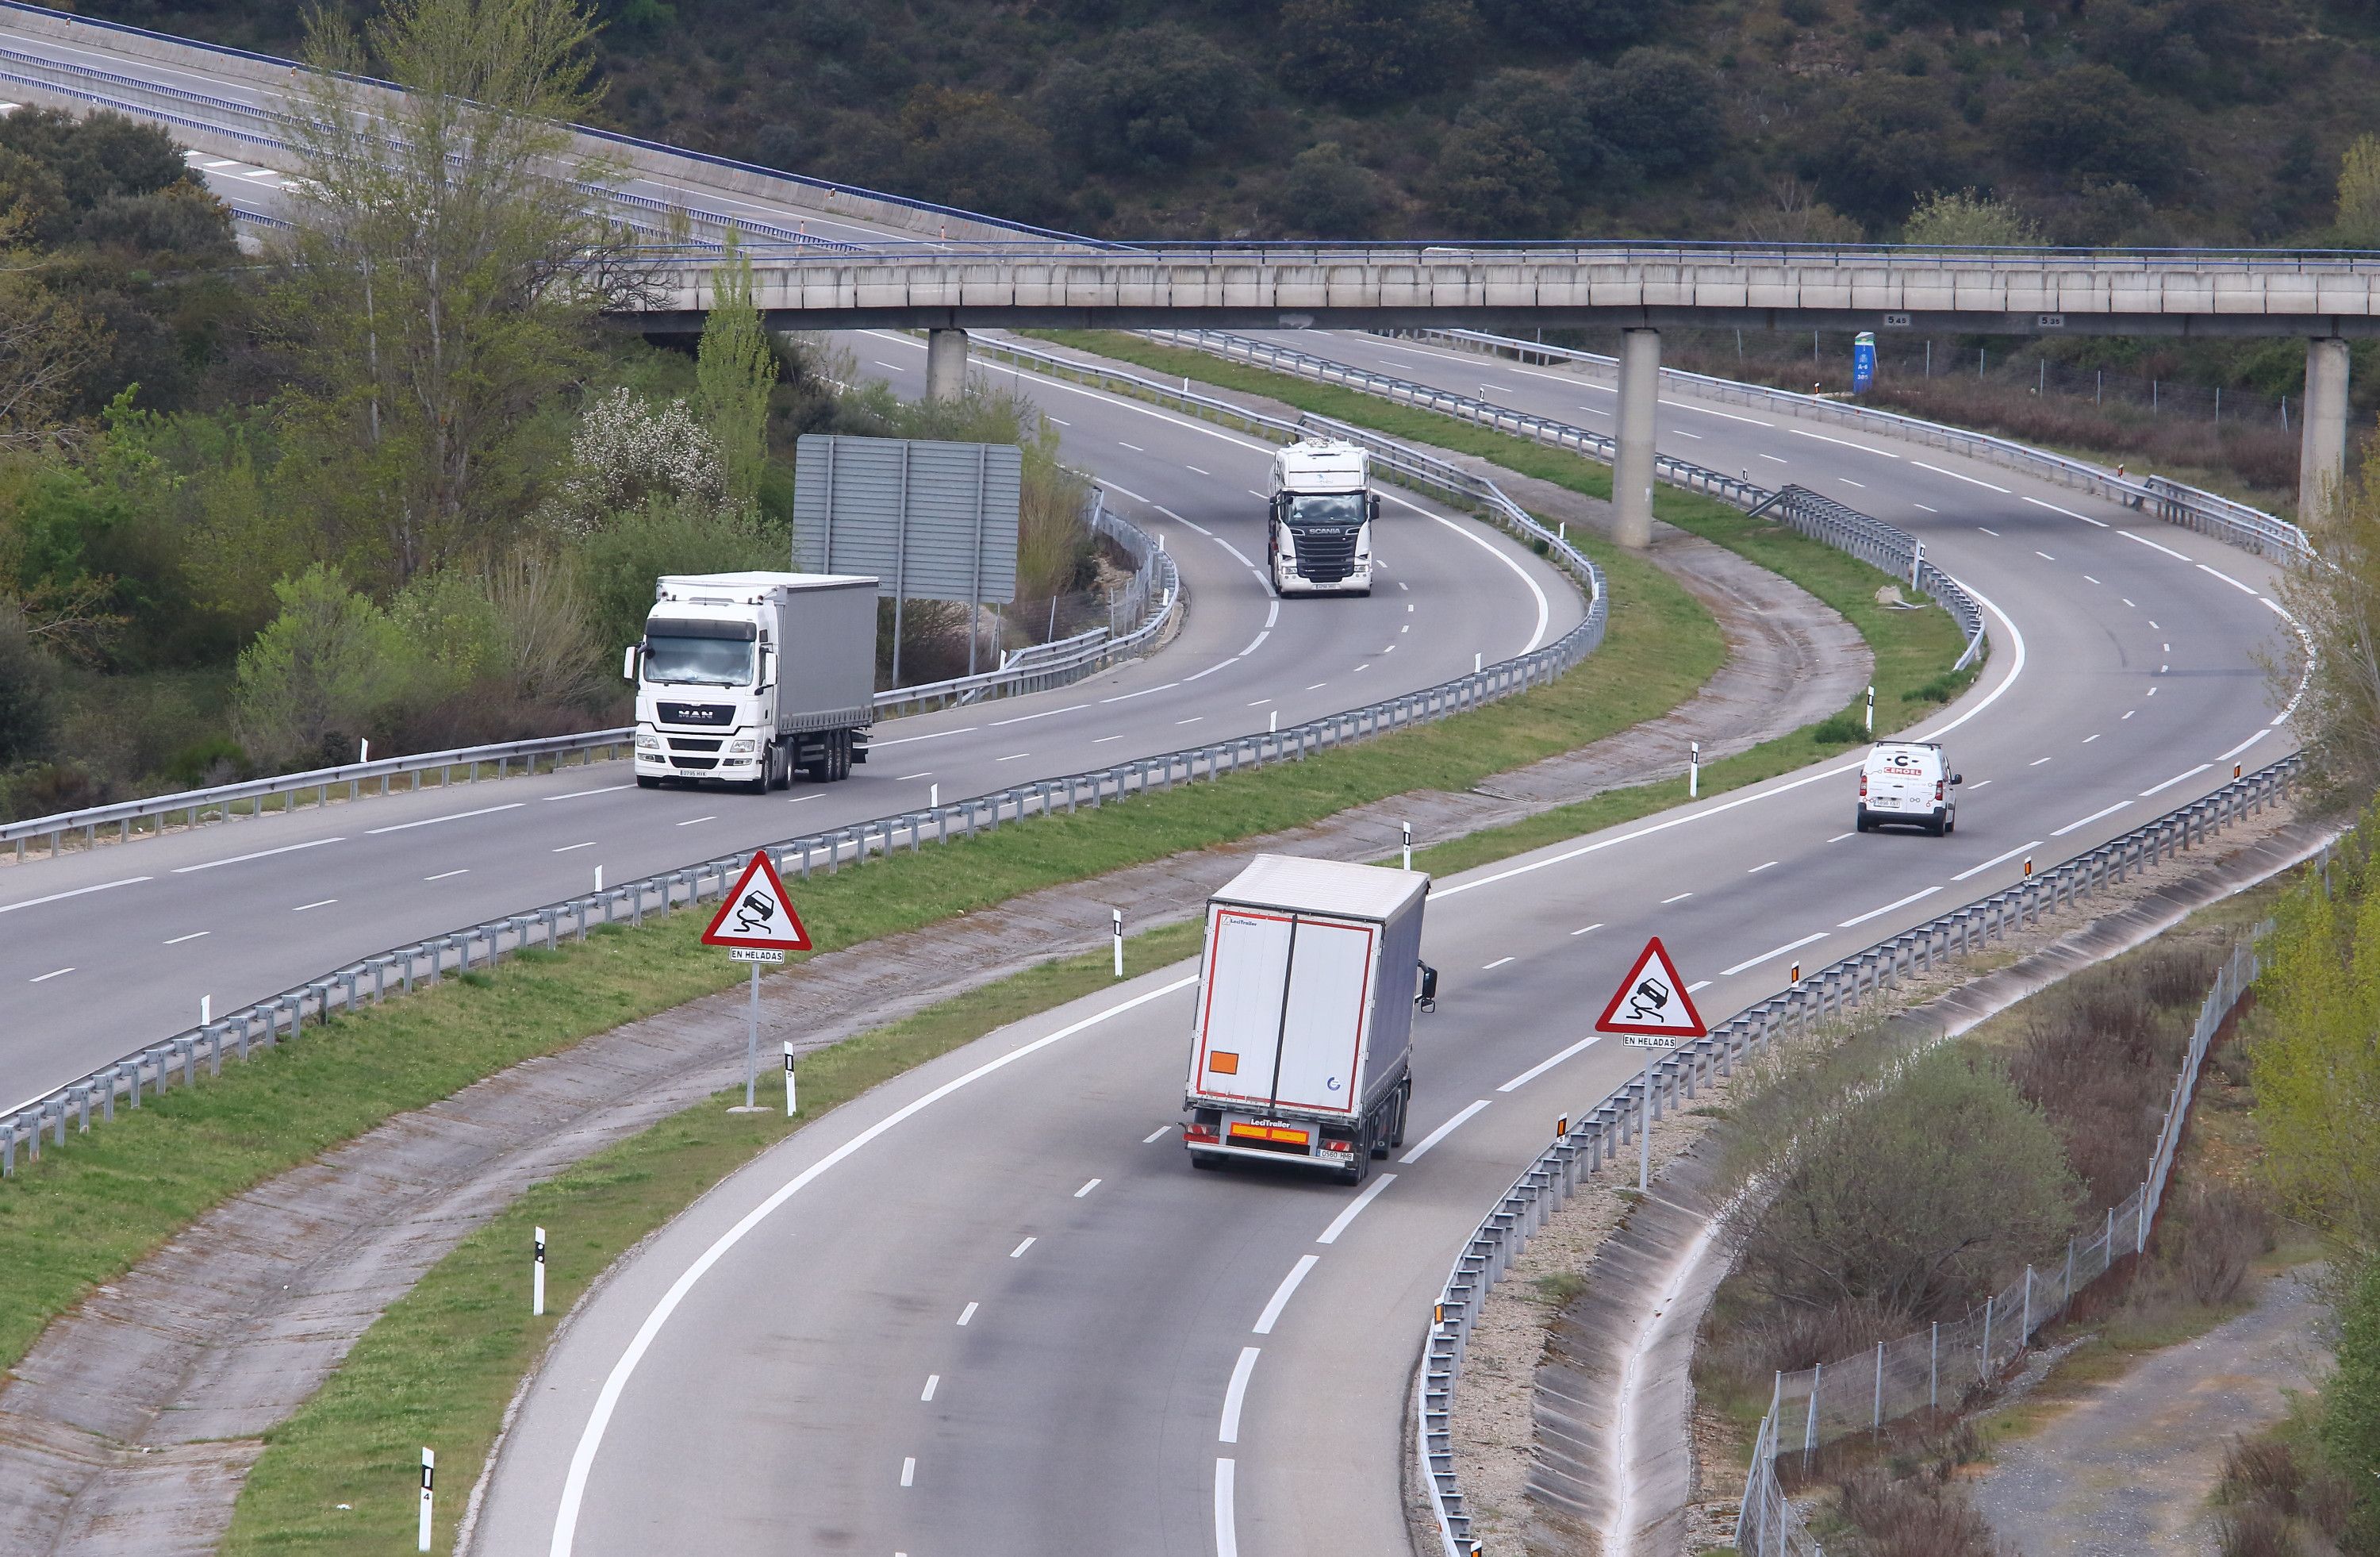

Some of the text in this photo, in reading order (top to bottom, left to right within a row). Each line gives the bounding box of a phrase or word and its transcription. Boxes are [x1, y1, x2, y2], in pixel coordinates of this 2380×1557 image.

[678, 710, 714, 719] MAN
[1231, 918, 1257, 927] LeciTrailer
[731, 950, 782, 961] EN HELADAS
[1624, 1036, 1676, 1048] EN HELADAS
[1250, 1118, 1291, 1128] LeciTrailer
[1340, 1152, 1353, 1161] HHB
